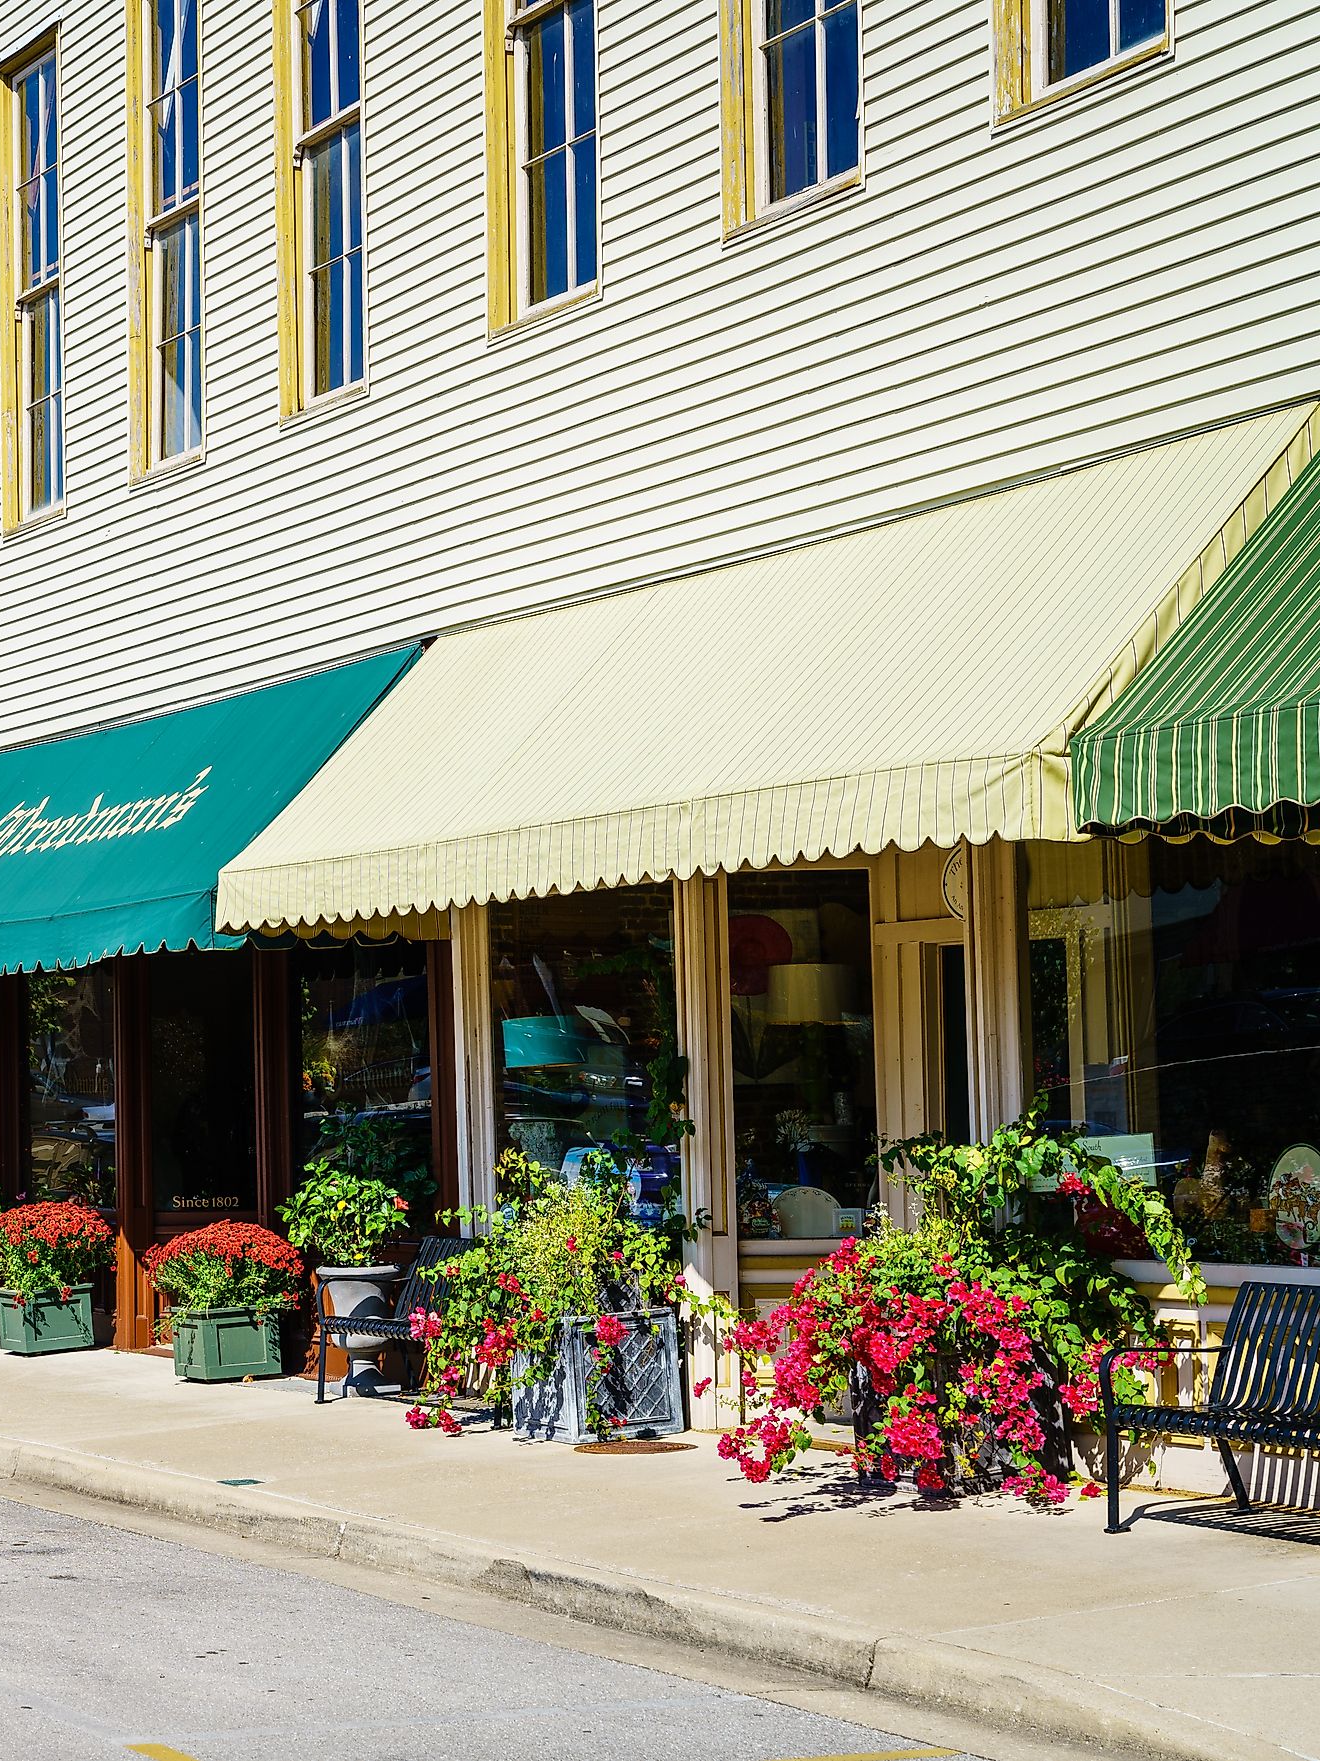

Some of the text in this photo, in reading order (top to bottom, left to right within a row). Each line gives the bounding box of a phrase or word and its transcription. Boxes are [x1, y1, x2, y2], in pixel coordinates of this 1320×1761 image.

[1082, 1140, 1102, 1152] South
[172, 1195, 239, 1208] Since 1802
